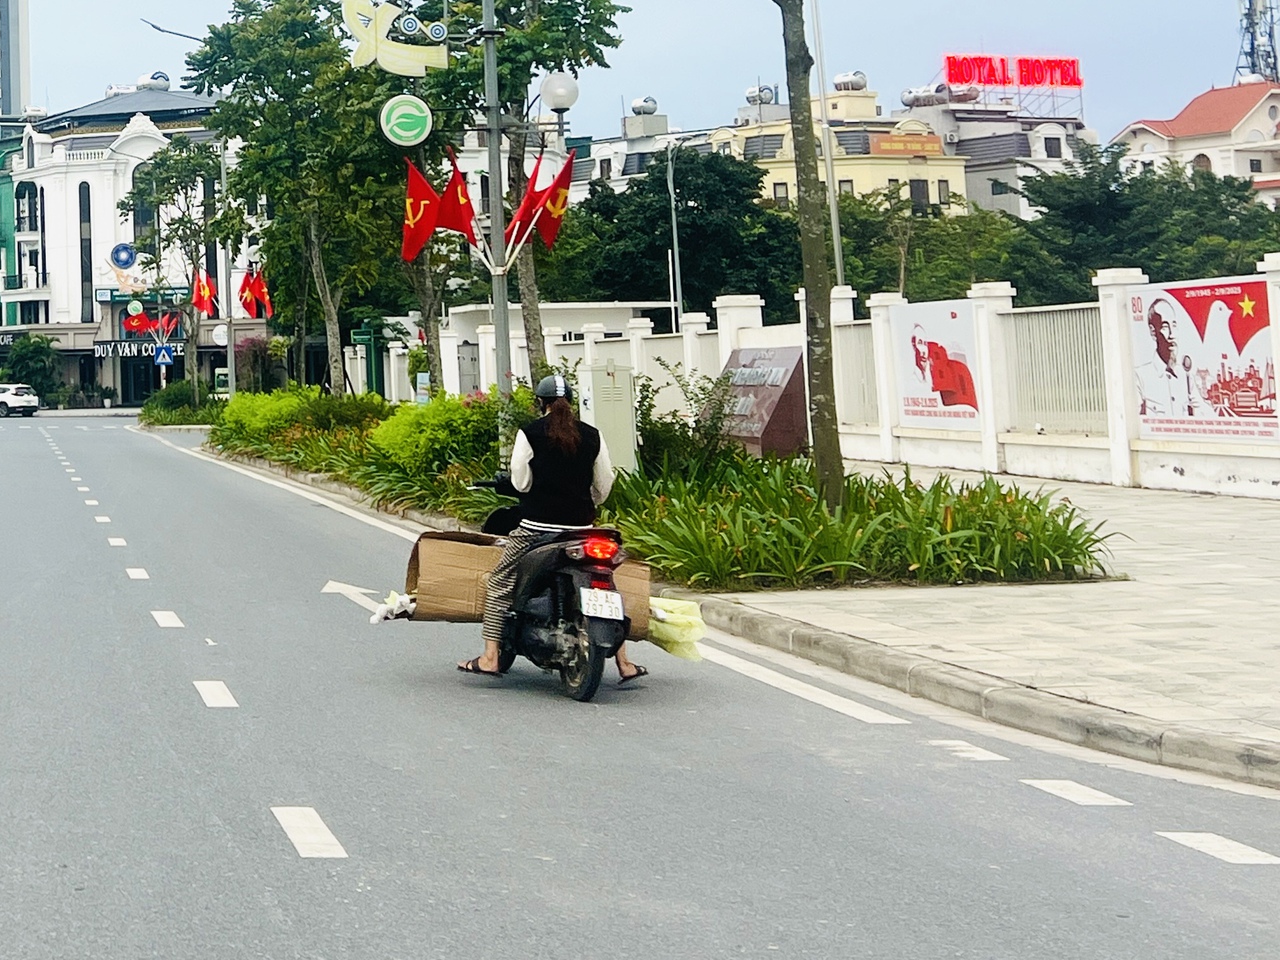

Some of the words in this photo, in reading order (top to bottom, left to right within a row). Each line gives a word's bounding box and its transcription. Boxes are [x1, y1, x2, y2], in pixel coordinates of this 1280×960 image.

[945, 54, 1012, 85] ROYAL
[1017, 57, 1083, 86] HOTEL
[1131, 297, 1143, 313] 80
[94, 342, 114, 357] DUY
[142, 343, 185, 356] COEE
